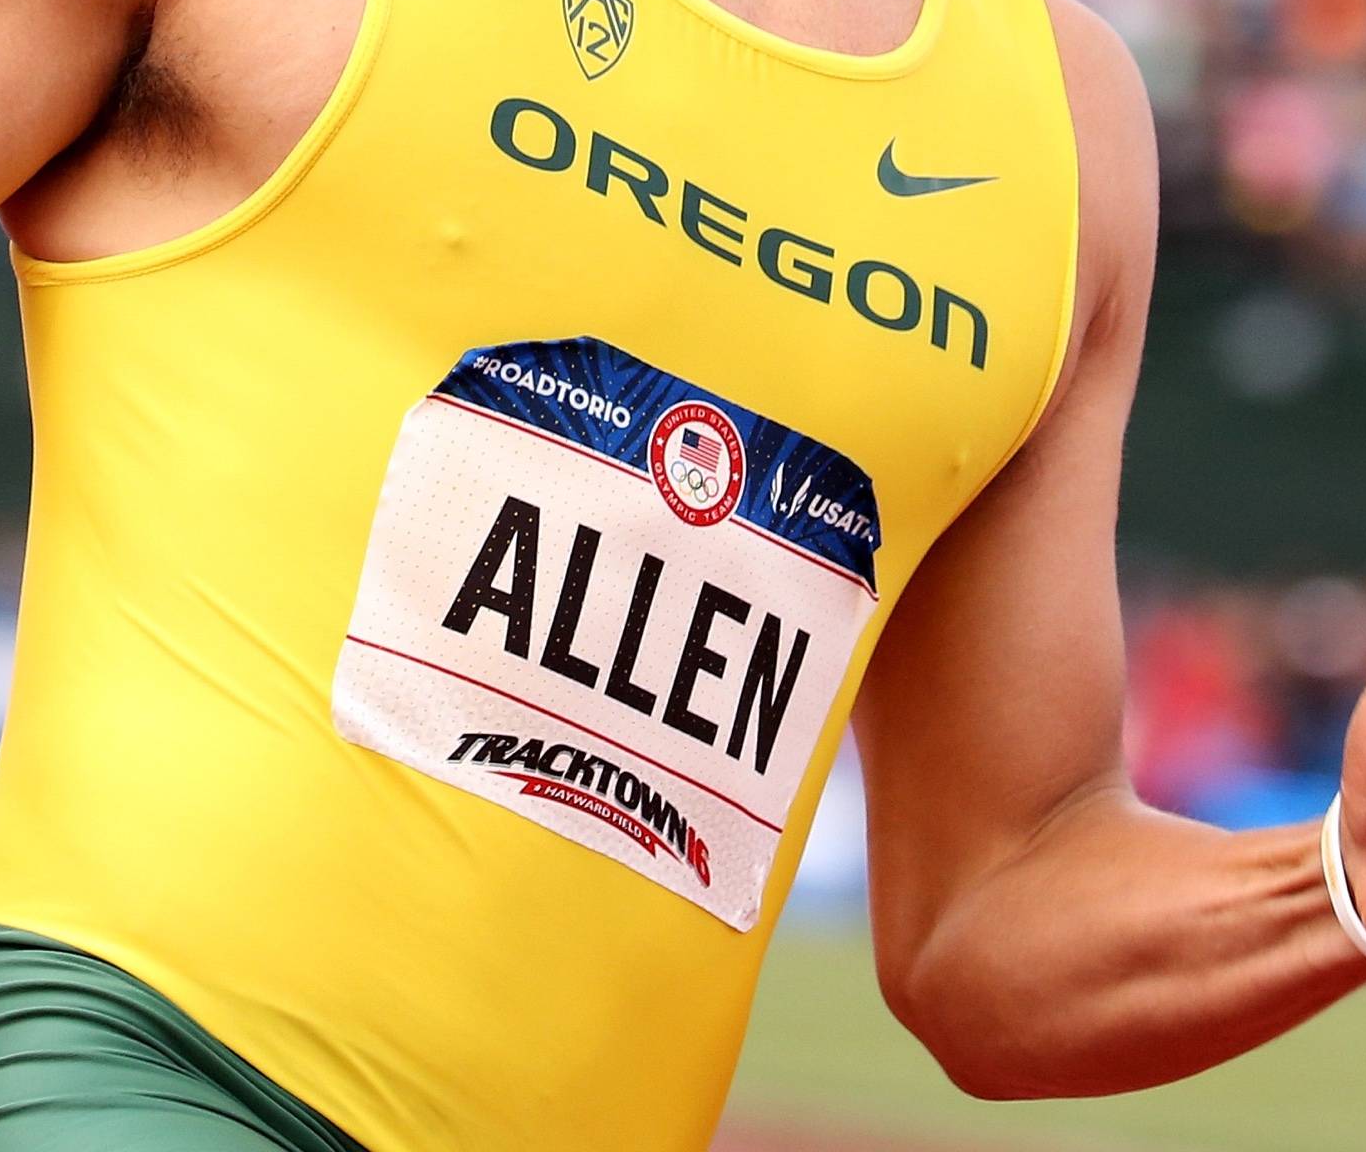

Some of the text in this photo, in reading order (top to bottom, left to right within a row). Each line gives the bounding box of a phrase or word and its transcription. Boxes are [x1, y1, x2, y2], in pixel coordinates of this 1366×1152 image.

[576, 16, 611, 62] 12
[490, 97, 989, 372] OREGON
[473, 356, 631, 429] #ROADTORIO
[664, 406, 741, 462] UNITED STATES
[654, 462, 734, 522] OLYMPIC TEAM
[442, 496, 811, 776] ALLEN
[544, 785, 643, 839] HAYWARD FIELD
